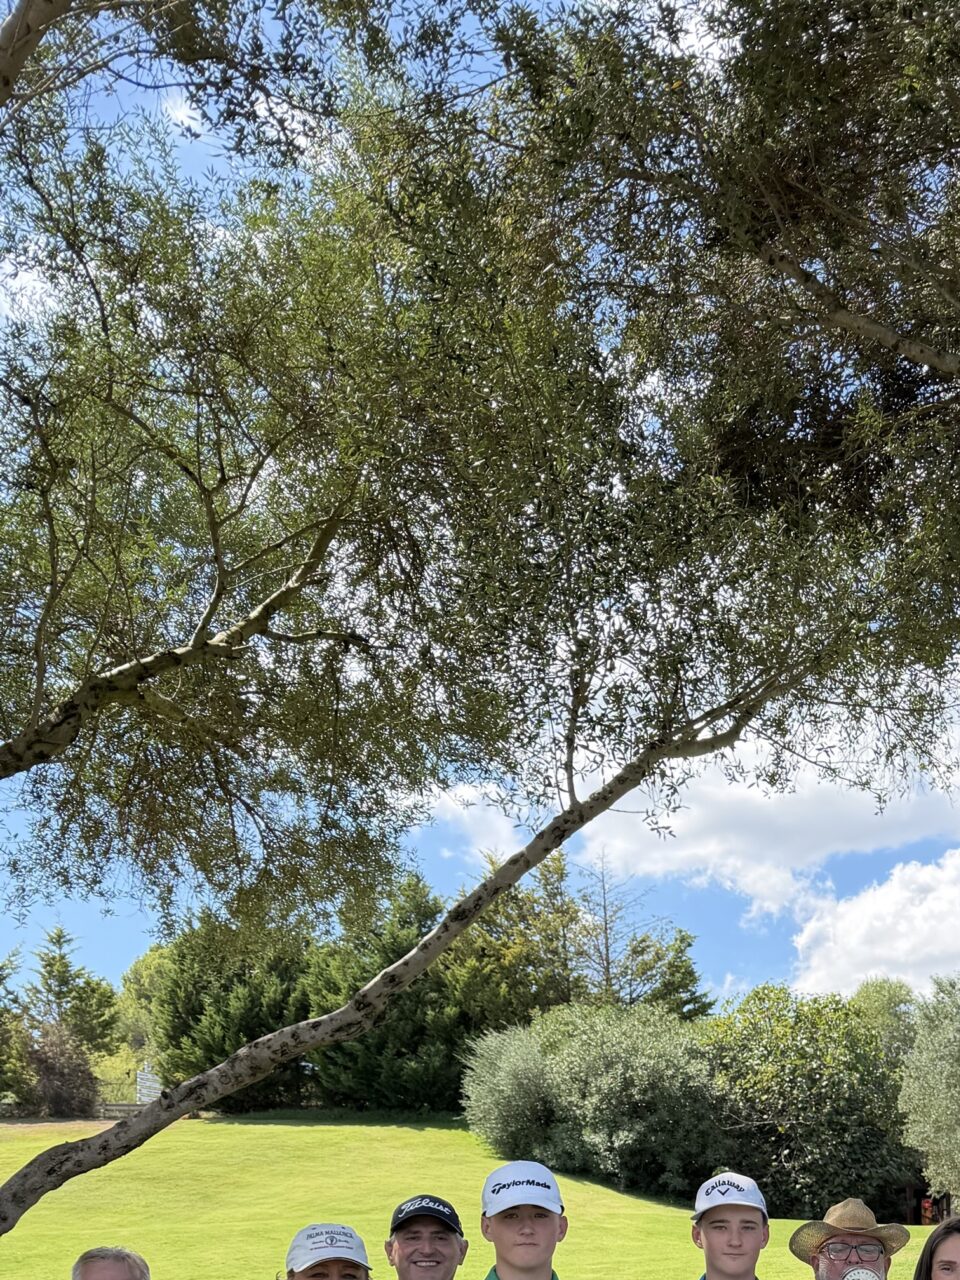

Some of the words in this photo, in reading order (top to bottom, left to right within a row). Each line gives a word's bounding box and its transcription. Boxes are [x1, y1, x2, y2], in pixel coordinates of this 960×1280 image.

[491, 1179, 552, 1195] TaylorMade
[705, 1180, 745, 1196] Callaway
[398, 1198, 452, 1218] Titleist
